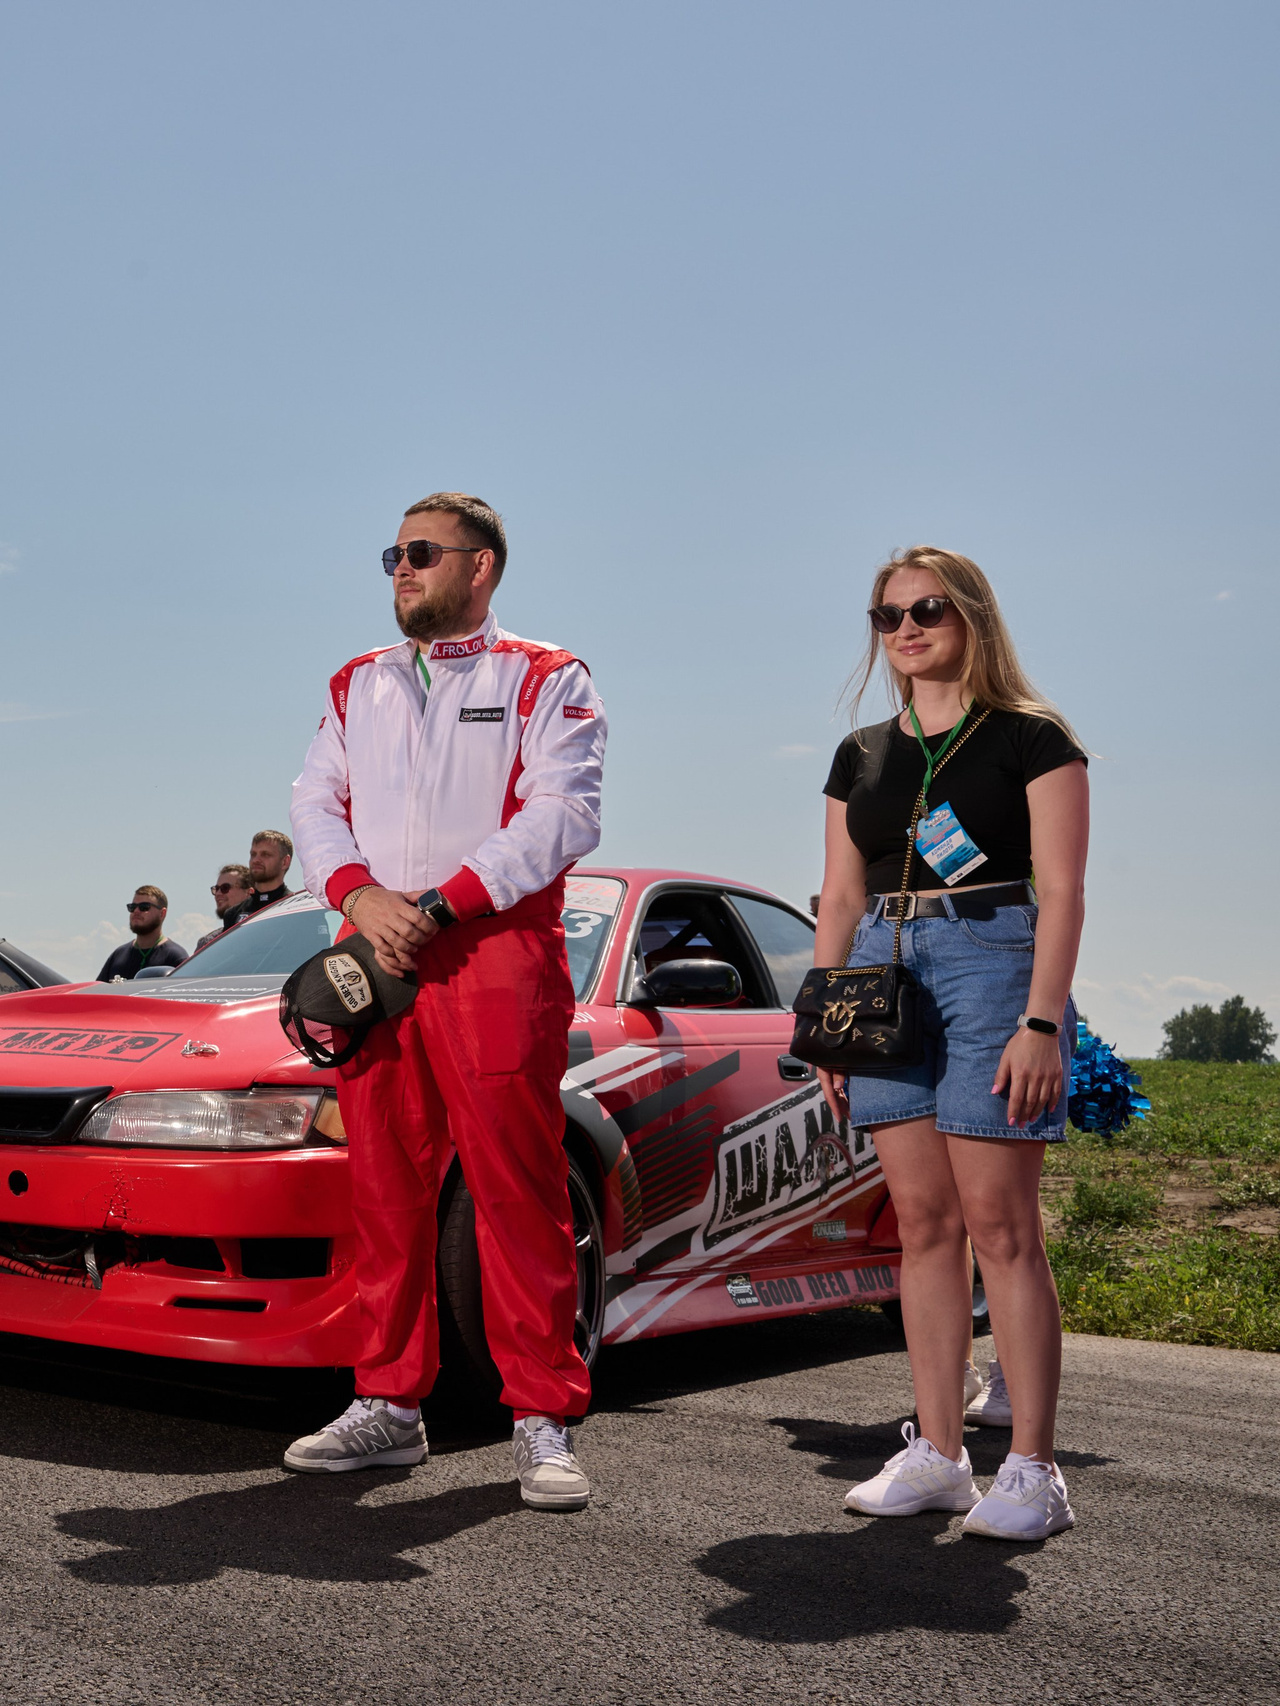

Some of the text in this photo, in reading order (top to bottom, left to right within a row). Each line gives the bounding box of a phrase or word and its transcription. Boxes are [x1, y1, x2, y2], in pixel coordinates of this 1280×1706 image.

[432, 638, 483, 657] A.FROLOV
[524, 674, 539, 700] VOLSON
[338, 690, 346, 713] VOLSON
[564, 708, 592, 717] VOLSON
[561, 910, 602, 938] 3
[328, 960, 359, 1008] GOLDEN KNIGHTS
[755, 1278, 805, 1308] GOOD
[805, 1271, 851, 1300] DEED
[853, 1264, 894, 1293] AUTO
